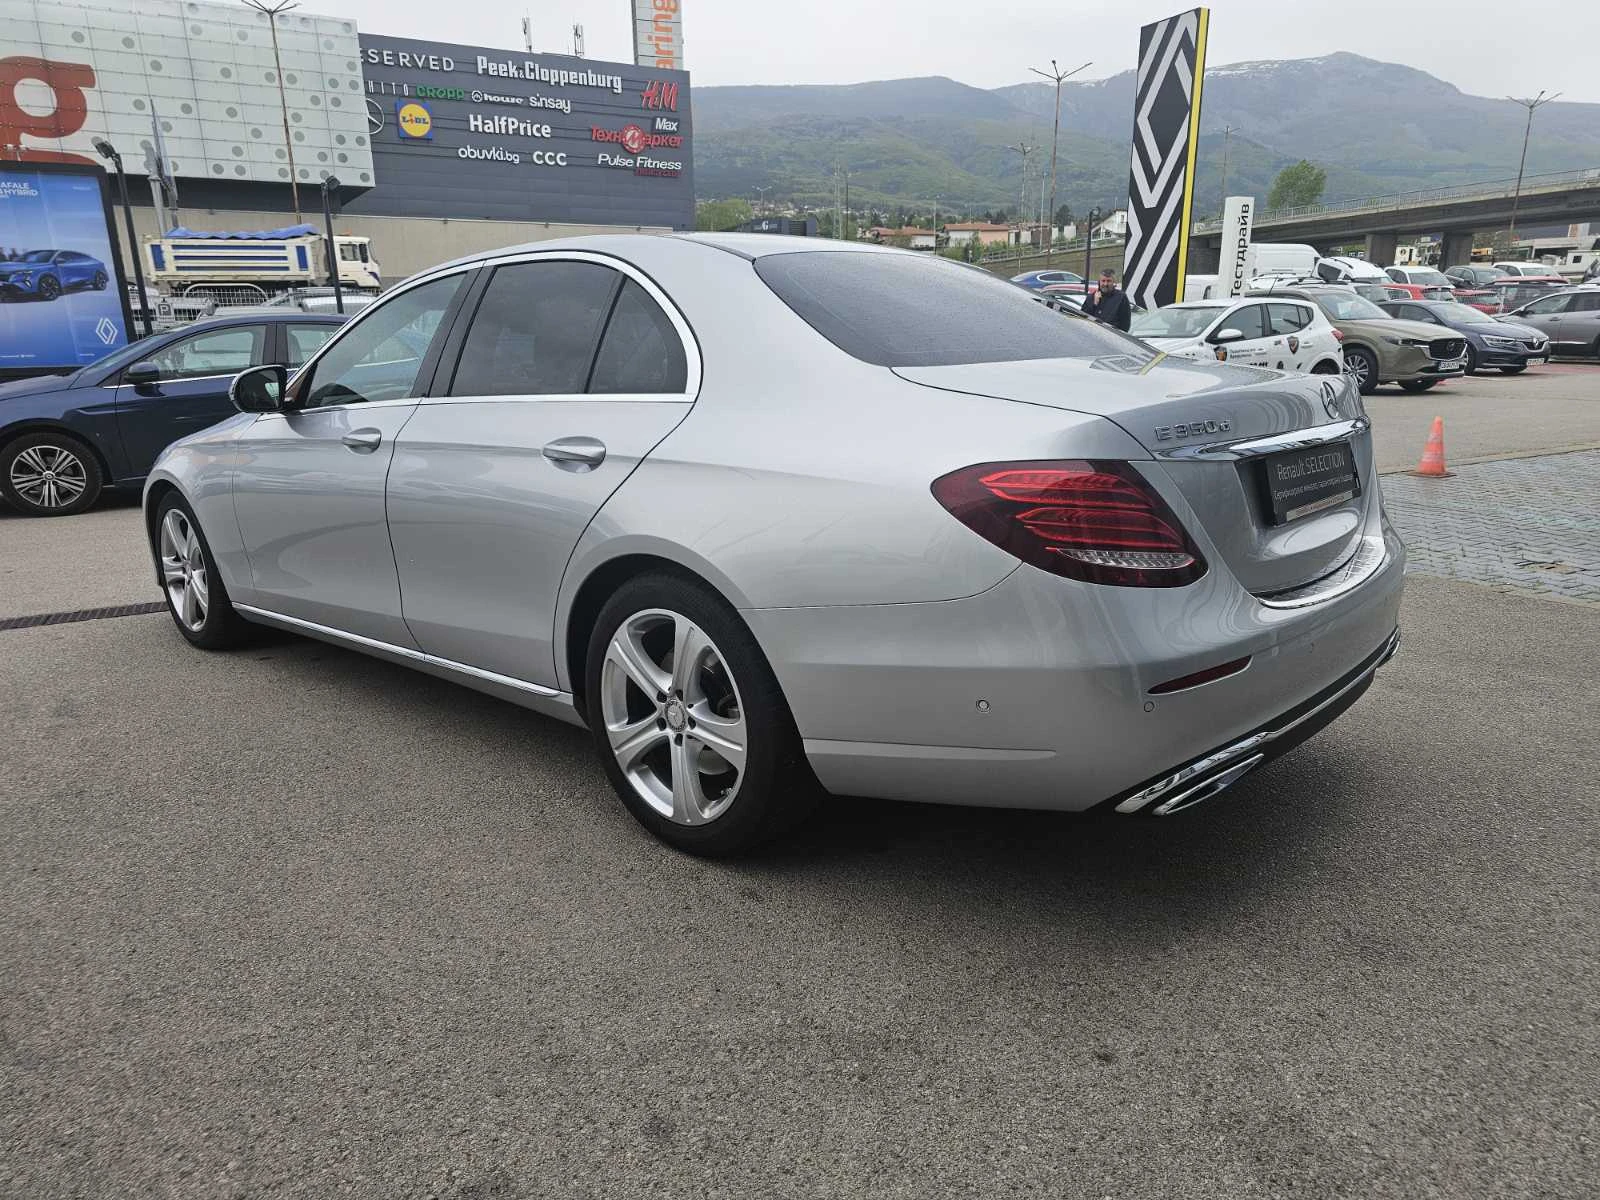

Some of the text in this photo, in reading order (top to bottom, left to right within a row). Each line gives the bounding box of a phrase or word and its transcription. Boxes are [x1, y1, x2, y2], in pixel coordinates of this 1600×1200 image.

[529, 93, 571, 113] sinsay
[641, 80, 679, 112] H&M
[469, 114, 551, 138] HalfPrice
[655, 117, 677, 132] Max
[458, 145, 519, 164] obuvki.bg
[533, 151, 567, 166] CCC
[598, 153, 682, 170] Pulse Fitness
[1231, 203, 1250, 298] Тестдрайв
[1277, 452, 1345, 481] Renault SELECTION
